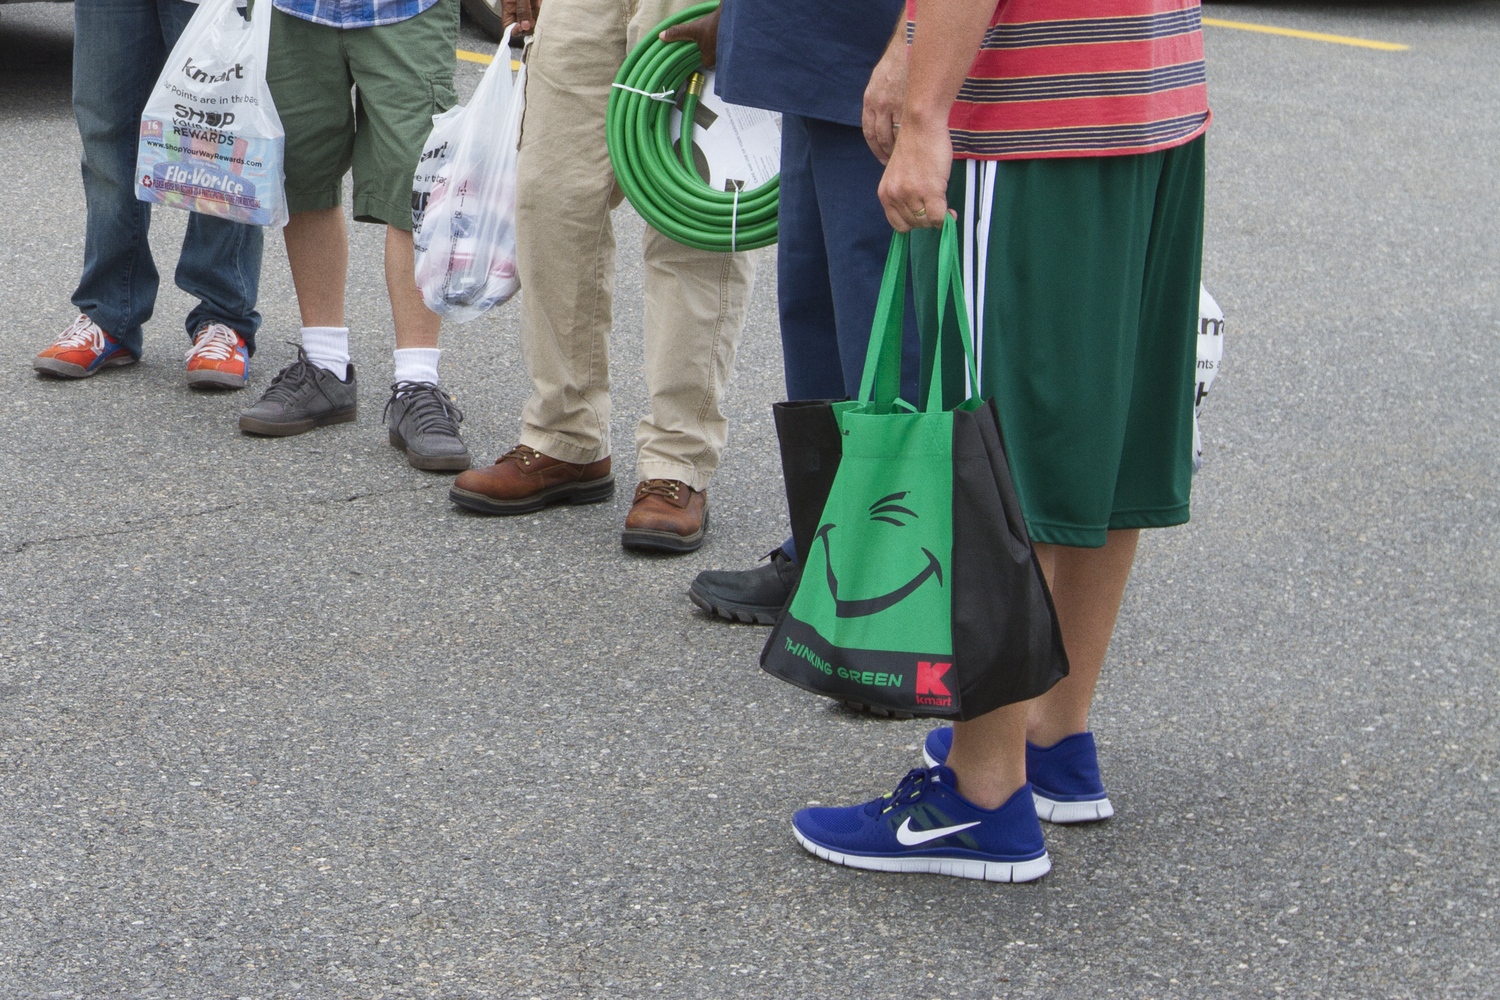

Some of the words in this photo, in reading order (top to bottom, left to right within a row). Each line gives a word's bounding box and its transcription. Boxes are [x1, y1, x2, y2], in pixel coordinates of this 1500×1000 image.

[171, 85, 198, 101] Points
[200, 96, 217, 105] are
[219, 96, 229, 104] in
[147, 120, 159, 130] 16
[173, 126, 235, 146] REWARDS
[146, 139, 263, 168] www.ShopYourWayRewards.com
[784, 636, 833, 675] THINKING
[837, 667, 903, 688] GREEN
[916, 695, 952, 706] kmart
